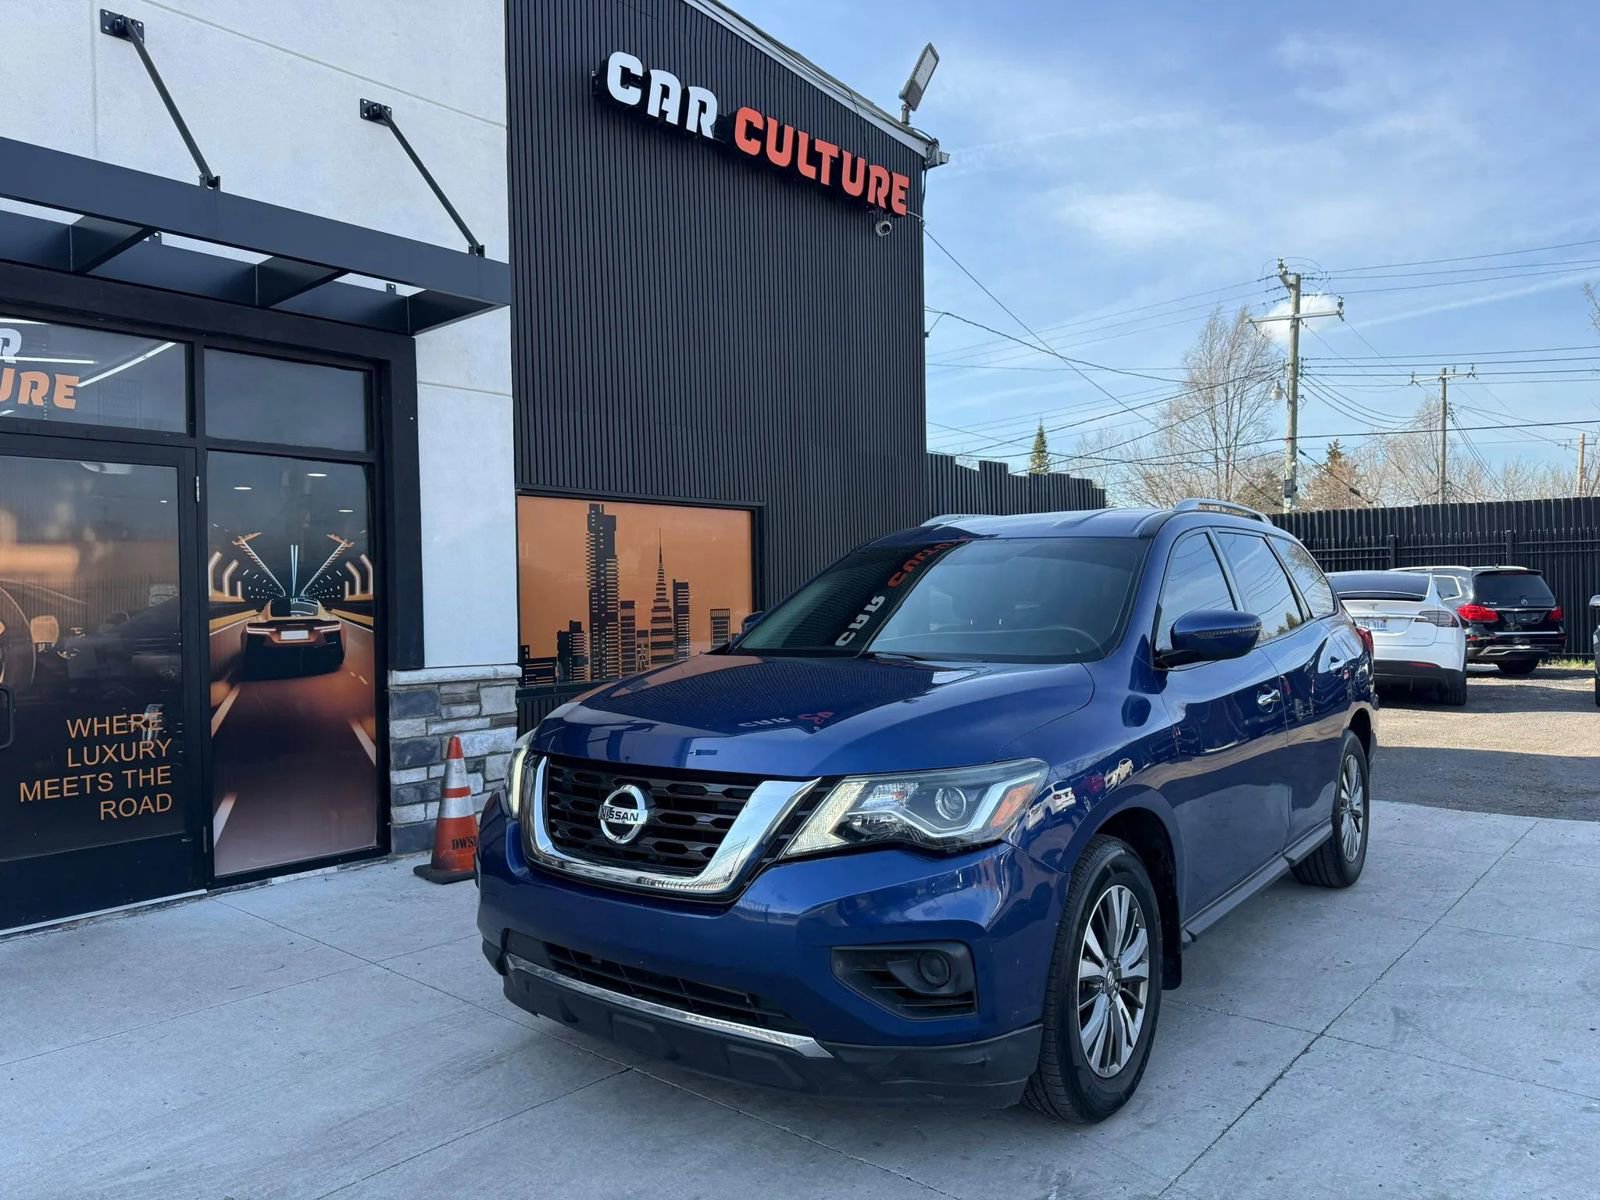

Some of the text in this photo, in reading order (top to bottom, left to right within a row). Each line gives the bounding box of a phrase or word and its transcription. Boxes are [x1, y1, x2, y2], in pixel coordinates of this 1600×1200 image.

[606, 51, 910, 216] CAR CULTURE
[66, 712, 164, 739] WHERE
[67, 739, 172, 767] LUXURY
[19, 765, 172, 802] MEETS THE
[100, 793, 173, 821] ROAD
[601, 807, 640, 822] NISSAN
